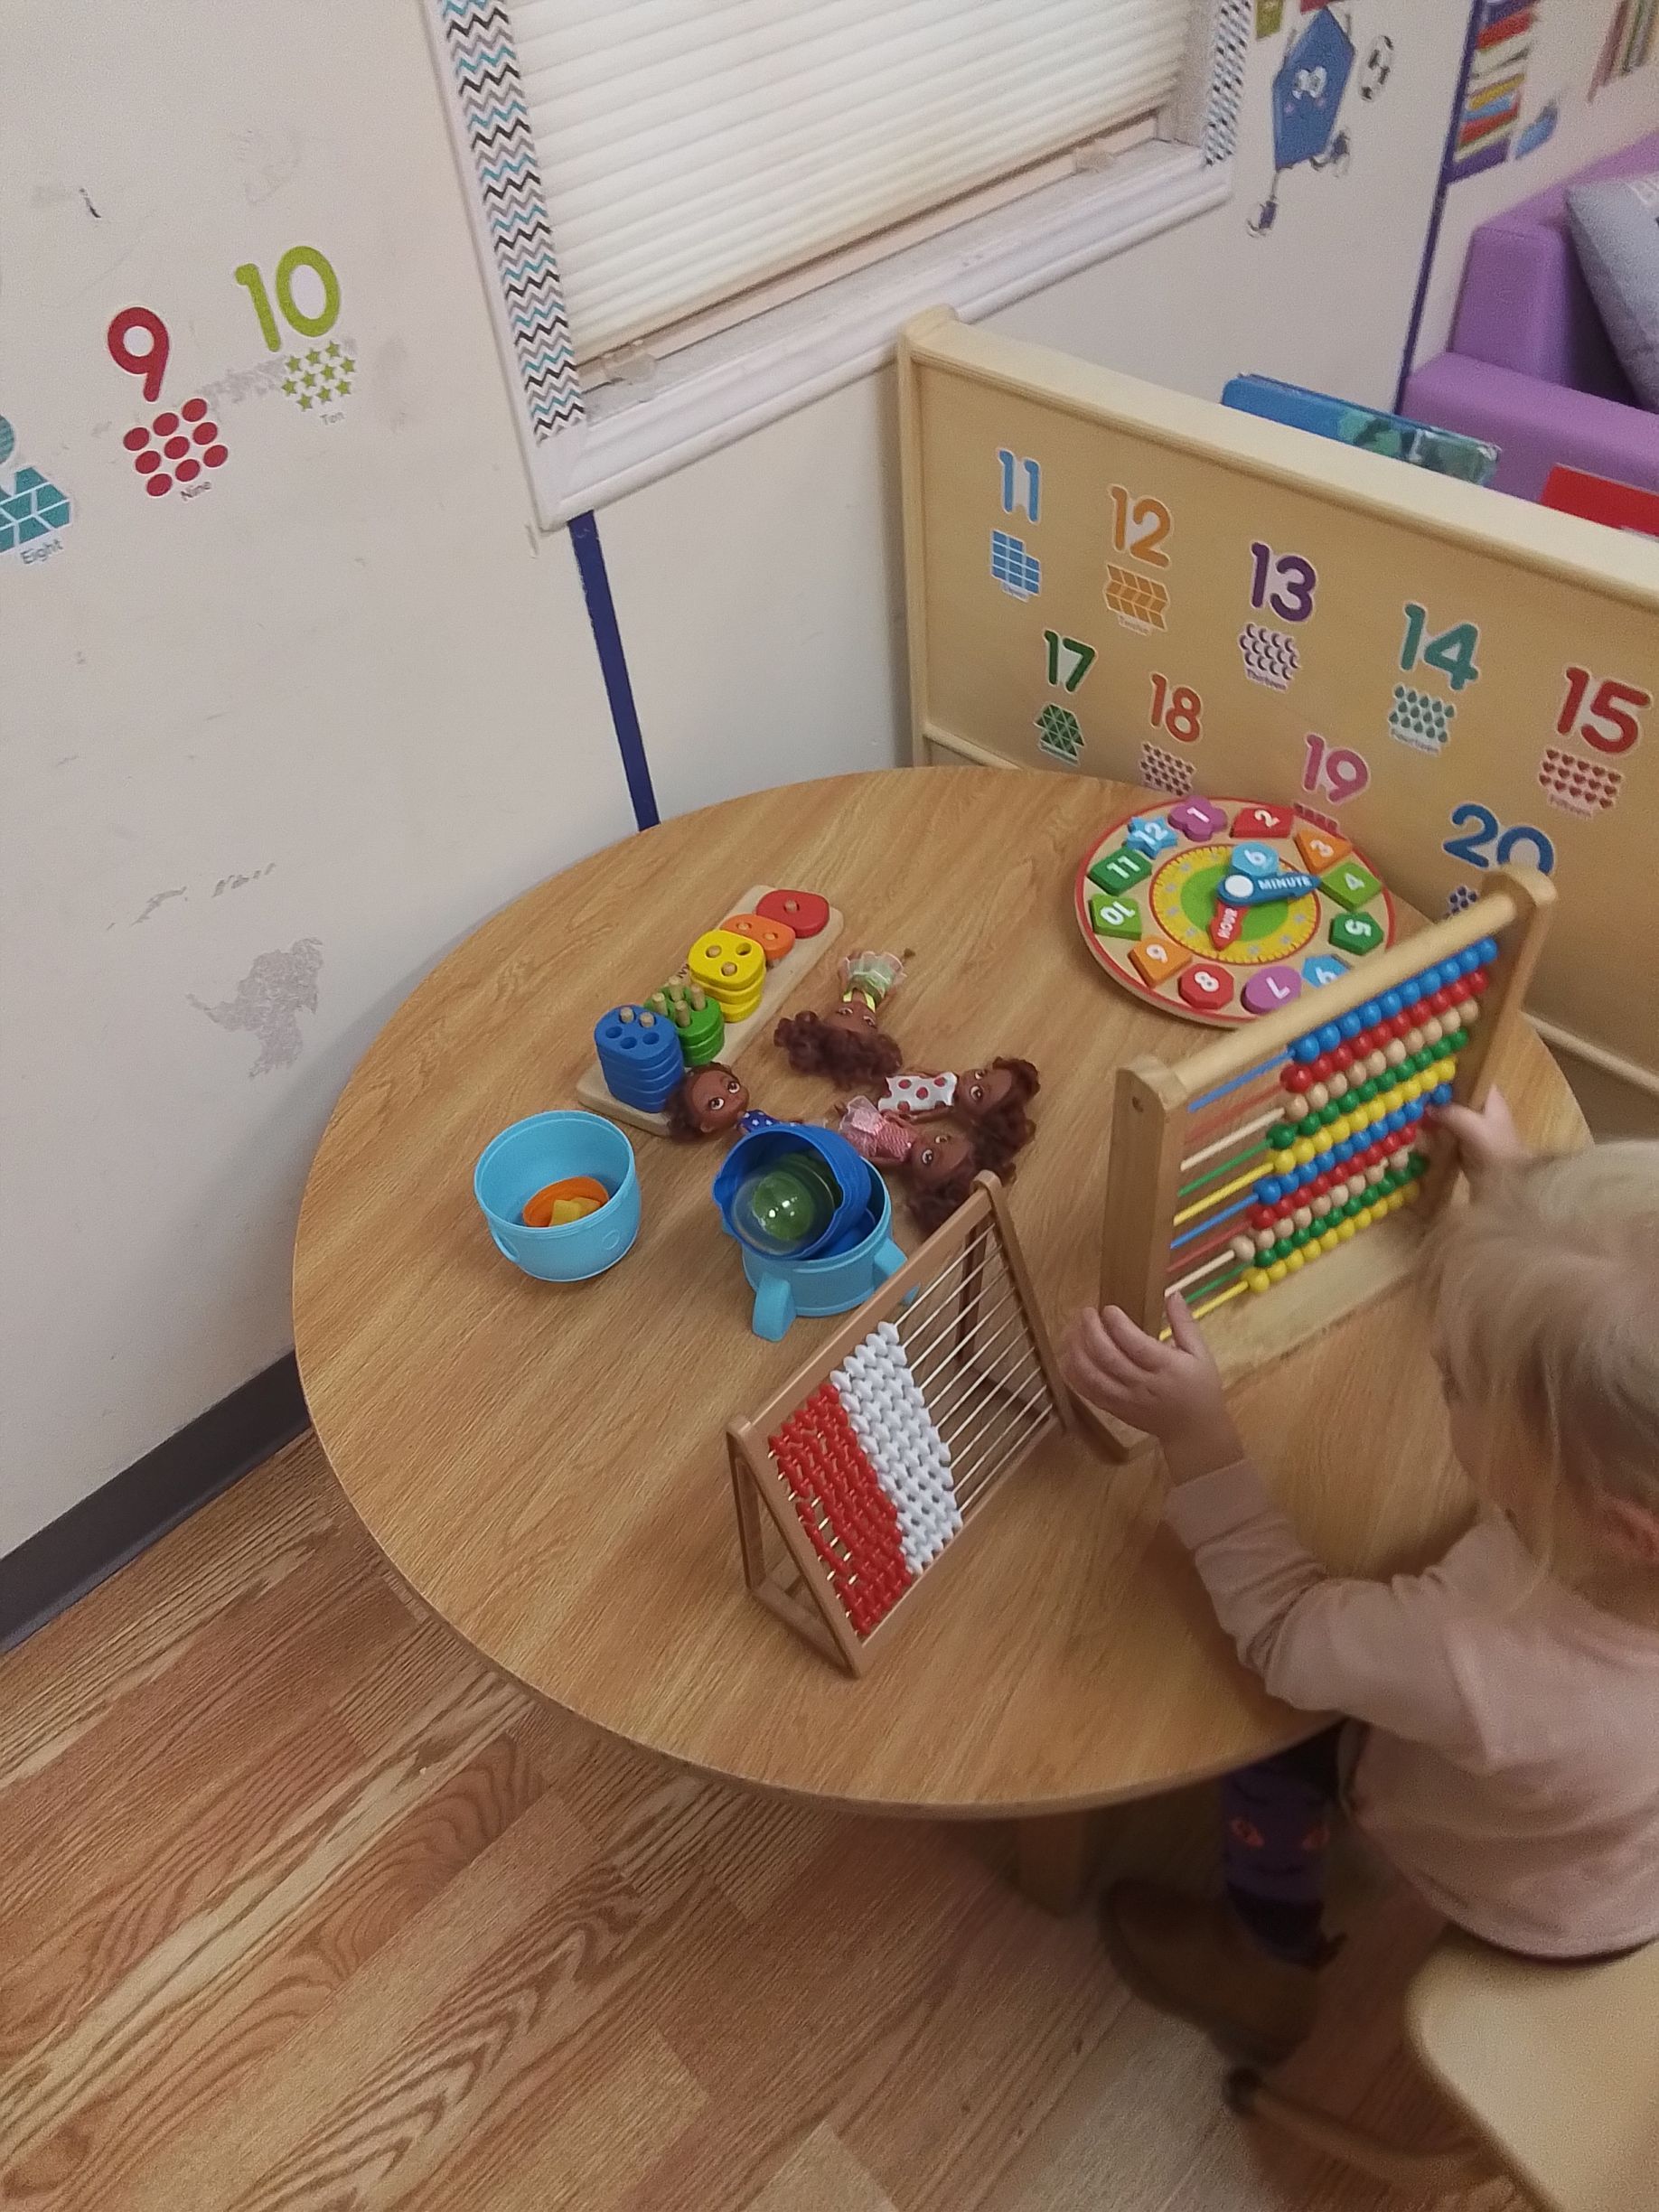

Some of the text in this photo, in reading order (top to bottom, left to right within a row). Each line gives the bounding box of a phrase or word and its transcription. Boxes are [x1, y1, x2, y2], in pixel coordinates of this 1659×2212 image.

[235, 246, 342, 352] 10
[108, 306, 170, 402] 9
[319, 411, 345, 426] Ten
[181, 481, 211, 501] Nine
[998, 449, 1040, 522] 11
[1111, 485, 1171, 568] 12
[20, 539, 63, 565] Eight
[1251, 541, 1317, 623] 13
[1400, 603, 1480, 691] 14
[1044, 630, 1097, 692] 17
[1151, 673, 1202, 743] 18
[1556, 667, 1651, 754] 15
[1302, 734, 1370, 802] 19
[1186, 806, 1211, 823] 1
[1254, 809, 1281, 828] 2
[1134, 822, 1168, 845] 12
[1442, 803, 1554, 876] 20
[1309, 839, 1335, 858] 3
[1106, 856, 1142, 880] 11
[1257, 875, 1313, 891] MINUTE
[1344, 872, 1365, 891] 4
[1100, 900, 1136, 926] 10
[1217, 906, 1238, 939] HOUR
[1345, 918, 1373, 937] 5
[1193, 970, 1220, 993] 8
[1265, 976, 1291, 999] 7
